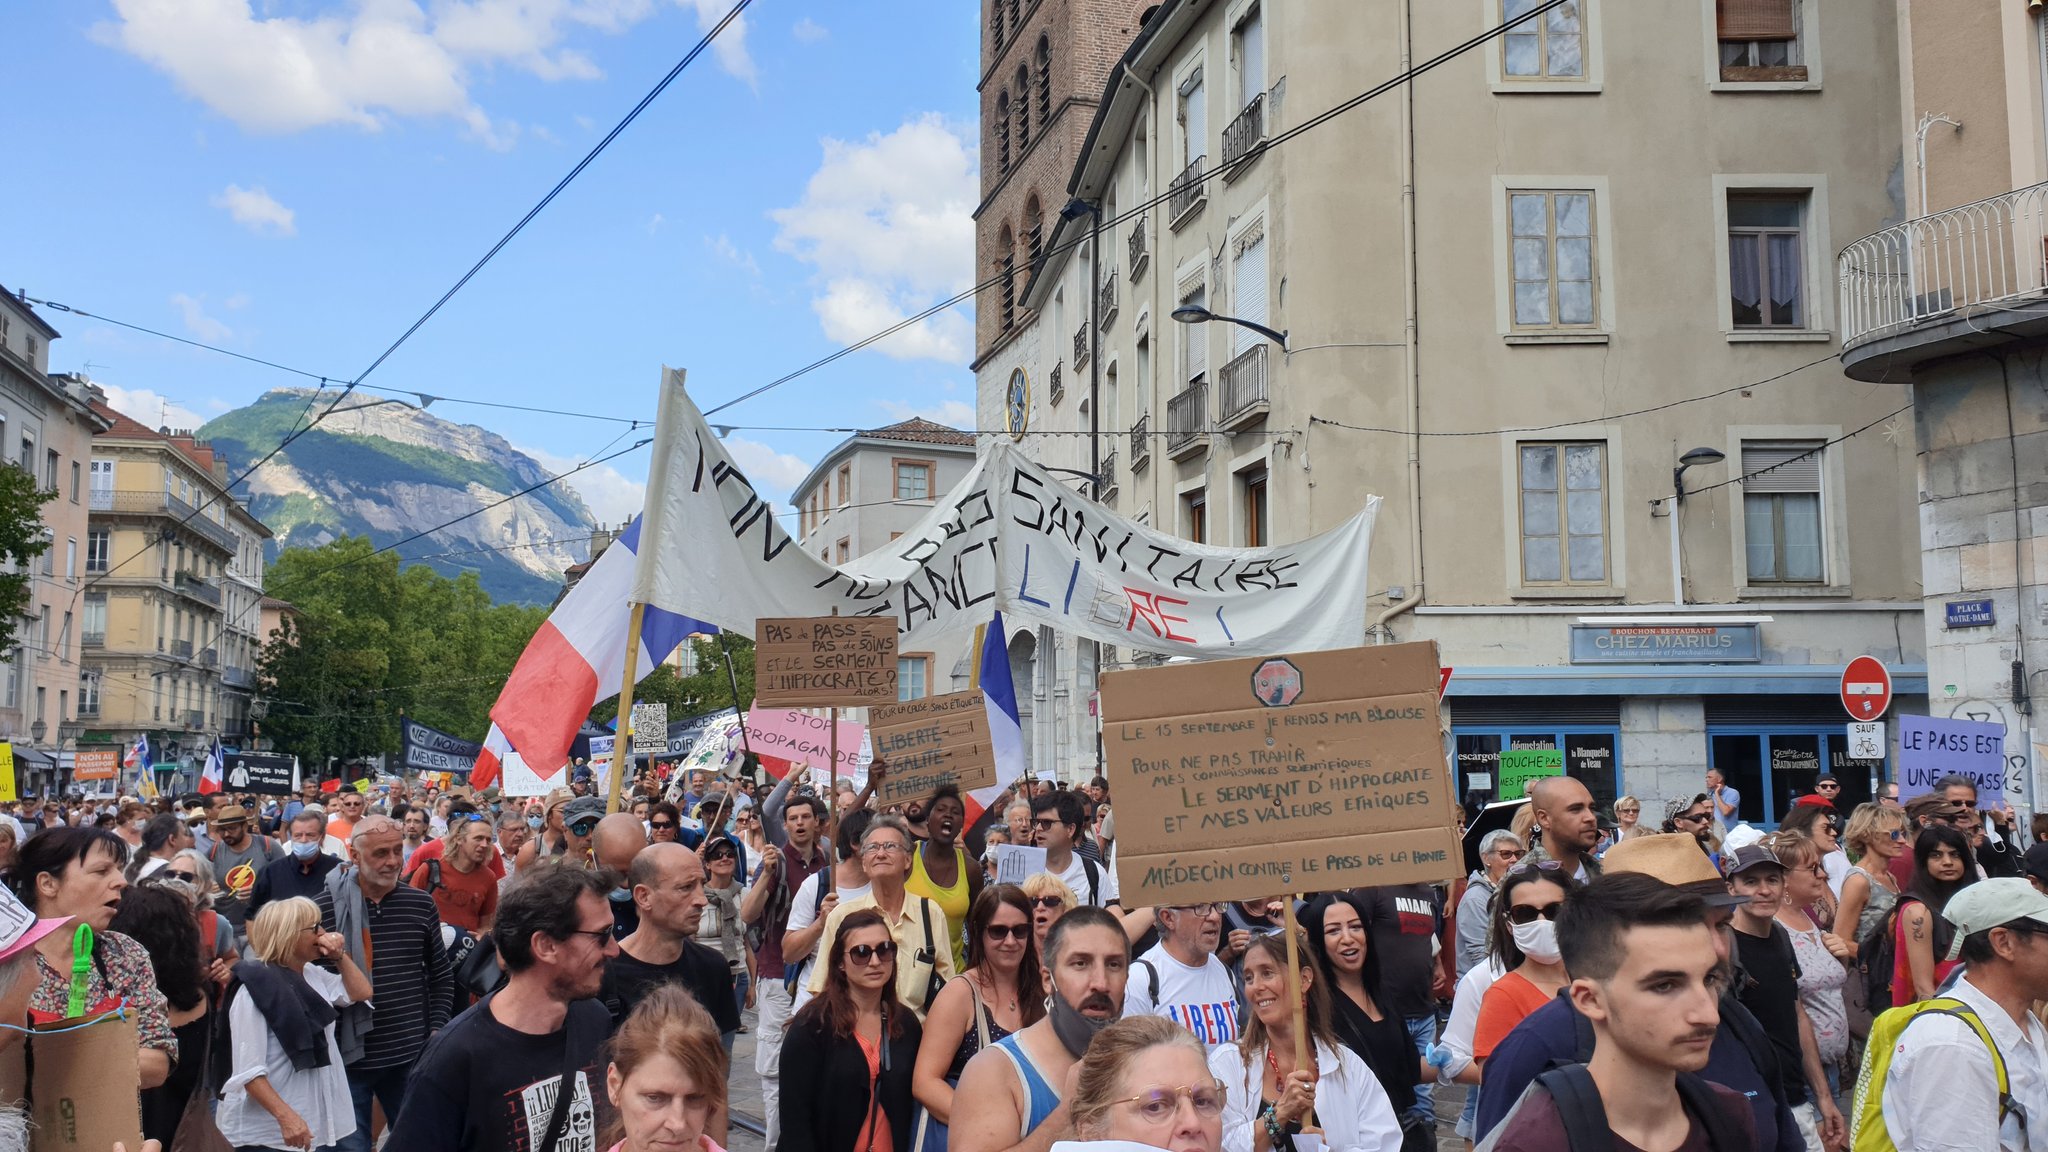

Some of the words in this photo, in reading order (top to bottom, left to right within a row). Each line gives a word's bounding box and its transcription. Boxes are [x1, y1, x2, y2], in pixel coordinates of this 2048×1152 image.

[1018, 543, 1197, 643] LIBRE
[1957, 603, 1982, 613] PLACE
[1949, 613, 1991, 623] NOTRE-DAME
[765, 624, 792, 643] PAS
[813, 624, 857, 640] PASS
[1595, 635, 1650, 649] CHEZ
[1655, 635, 1732, 649] MARIUS
[812, 640, 836, 652] PAS
[843, 640, 855, 650] de
[767, 658, 780, 671] ET
[785, 657, 804, 670] LE
[813, 652, 890, 669] SERMENT
[786, 711, 833, 731] STOP
[872, 708, 897, 722] POUR
[897, 704, 906, 714] LA
[931, 701, 949, 712] SANS
[1122, 724, 1146, 741] LE
[1155, 724, 1172, 737] 15
[1181, 720, 1256, 735] SEPTEMBRE
[1285, 712, 1329, 726] RENDS
[1335, 711, 1362, 725] MA
[1367, 706, 1426, 723] BLOUSE
[1855, 724, 1876, 734] SAUF
[411, 727, 428, 743] NE
[433, 736, 467, 753] NOUS
[1904, 731, 1923, 750] LE
[1929, 731, 1968, 752] PASS
[1975, 735, 2001, 754] EST
[77, 760, 115, 768] PASSEPORT
[80, 753, 101, 761] NON
[411, 748, 449, 768] MENER
[1181, 756, 1201, 769] NE
[1210, 752, 1242, 768] PAS
[1250, 743, 1305, 766] TRAHIR
[1457, 752, 1500, 763] escargots
[1501, 755, 1544, 769] TOUCHE
[1545, 756, 1562, 766] PAS
[1152, 773, 1185, 788] MES
[1907, 768, 1941, 788] UNE
[1181, 787, 1207, 808] LE
[1217, 779, 1301, 803] SERMENT
[1164, 815, 1189, 833] ET
[1201, 808, 1249, 829] MES
[1254, 801, 1333, 823] VALEURS
[1344, 790, 1430, 811] ETHIQUES
[1141, 858, 1234, 889] MÉDECIN
[1238, 861, 1293, 877] CONTRE
[1302, 858, 1319, 872] LE
[1327, 854, 1363, 871] PASS
[1368, 853, 1385, 866] DE
[1391, 850, 1407, 863] LA
[1413, 849, 1448, 864] HONTE
